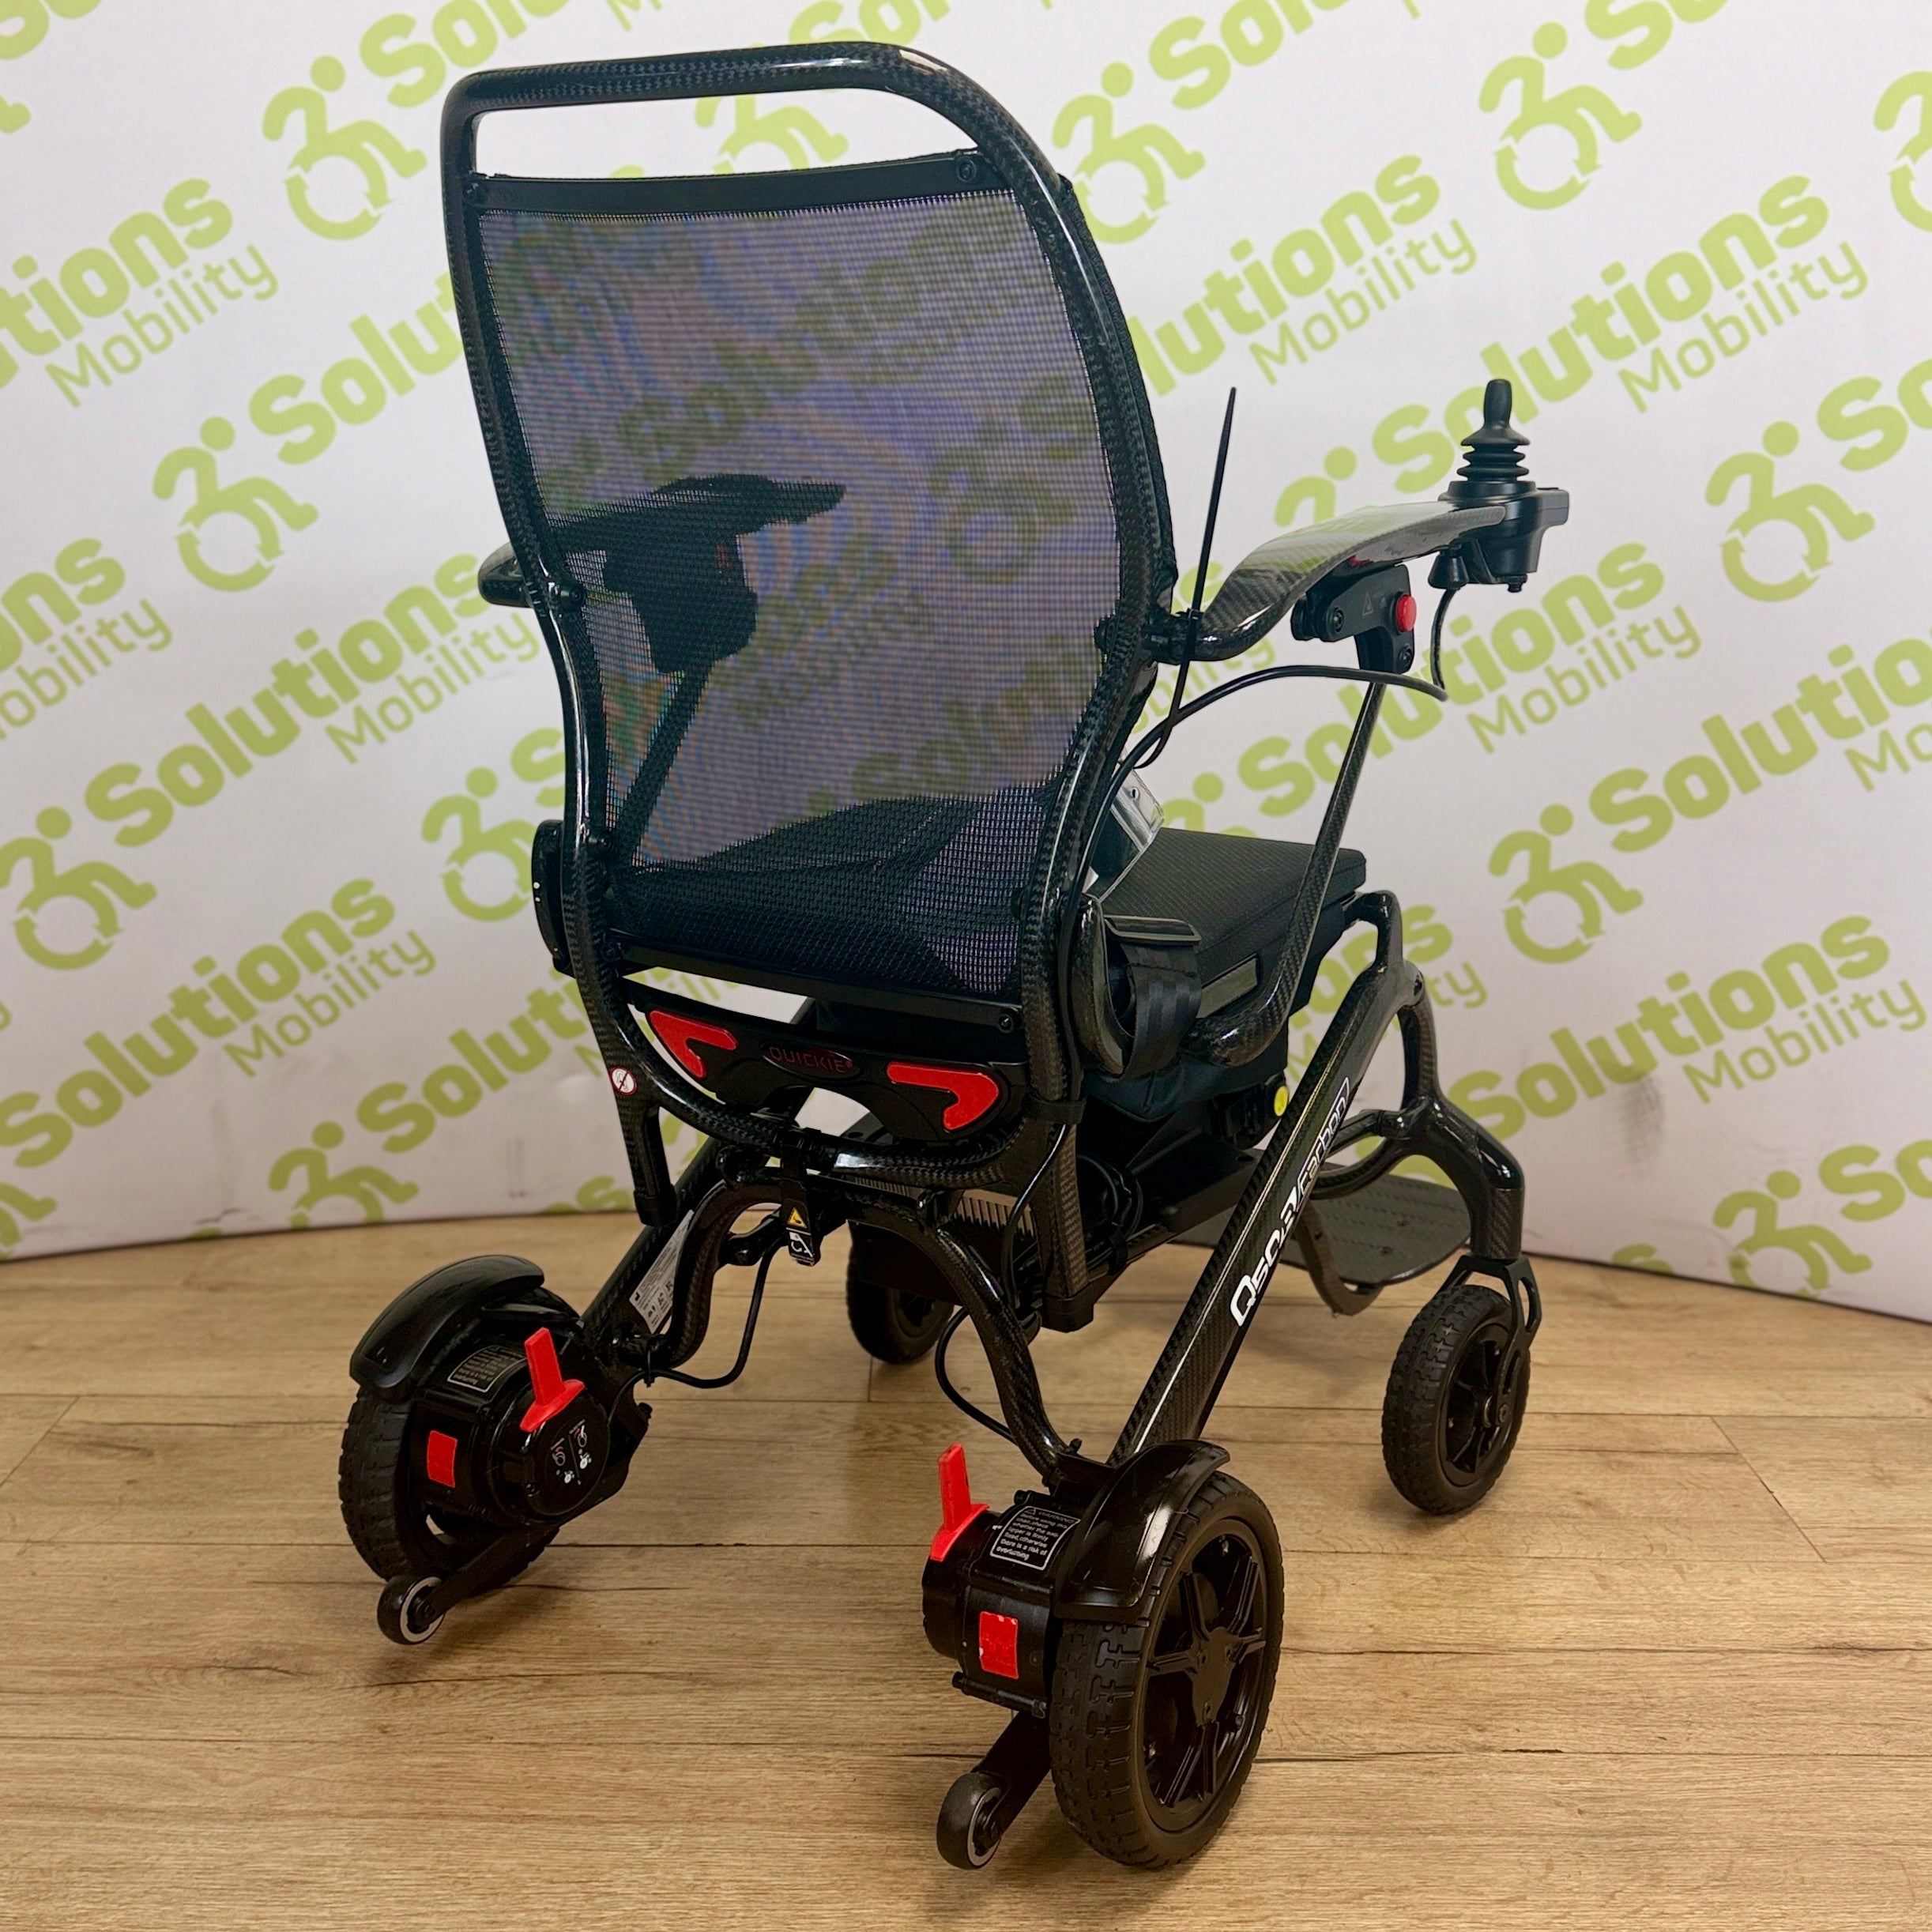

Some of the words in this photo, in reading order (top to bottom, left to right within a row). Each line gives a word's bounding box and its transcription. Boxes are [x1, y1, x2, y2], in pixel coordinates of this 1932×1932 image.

[45, 244, 278, 407] Mobility
[1248, 218, 1477, 385] Mobility
[1617, 239, 1868, 412] Mobility
[84, 552, 491, 847] Solutions
[324, 611, 540, 764] Mobility
[1237, 542, 1665, 817] Solutions
[1466, 604, 1702, 754] Mobility
[0, 878, 396, 1169] Solutions
[223, 930, 437, 1079] Mobility
[769, 1045, 847, 1075] QUICKIE
[1447, 915, 1890, 1142] Solutions
[1682, 979, 1929, 1105] Mobility
